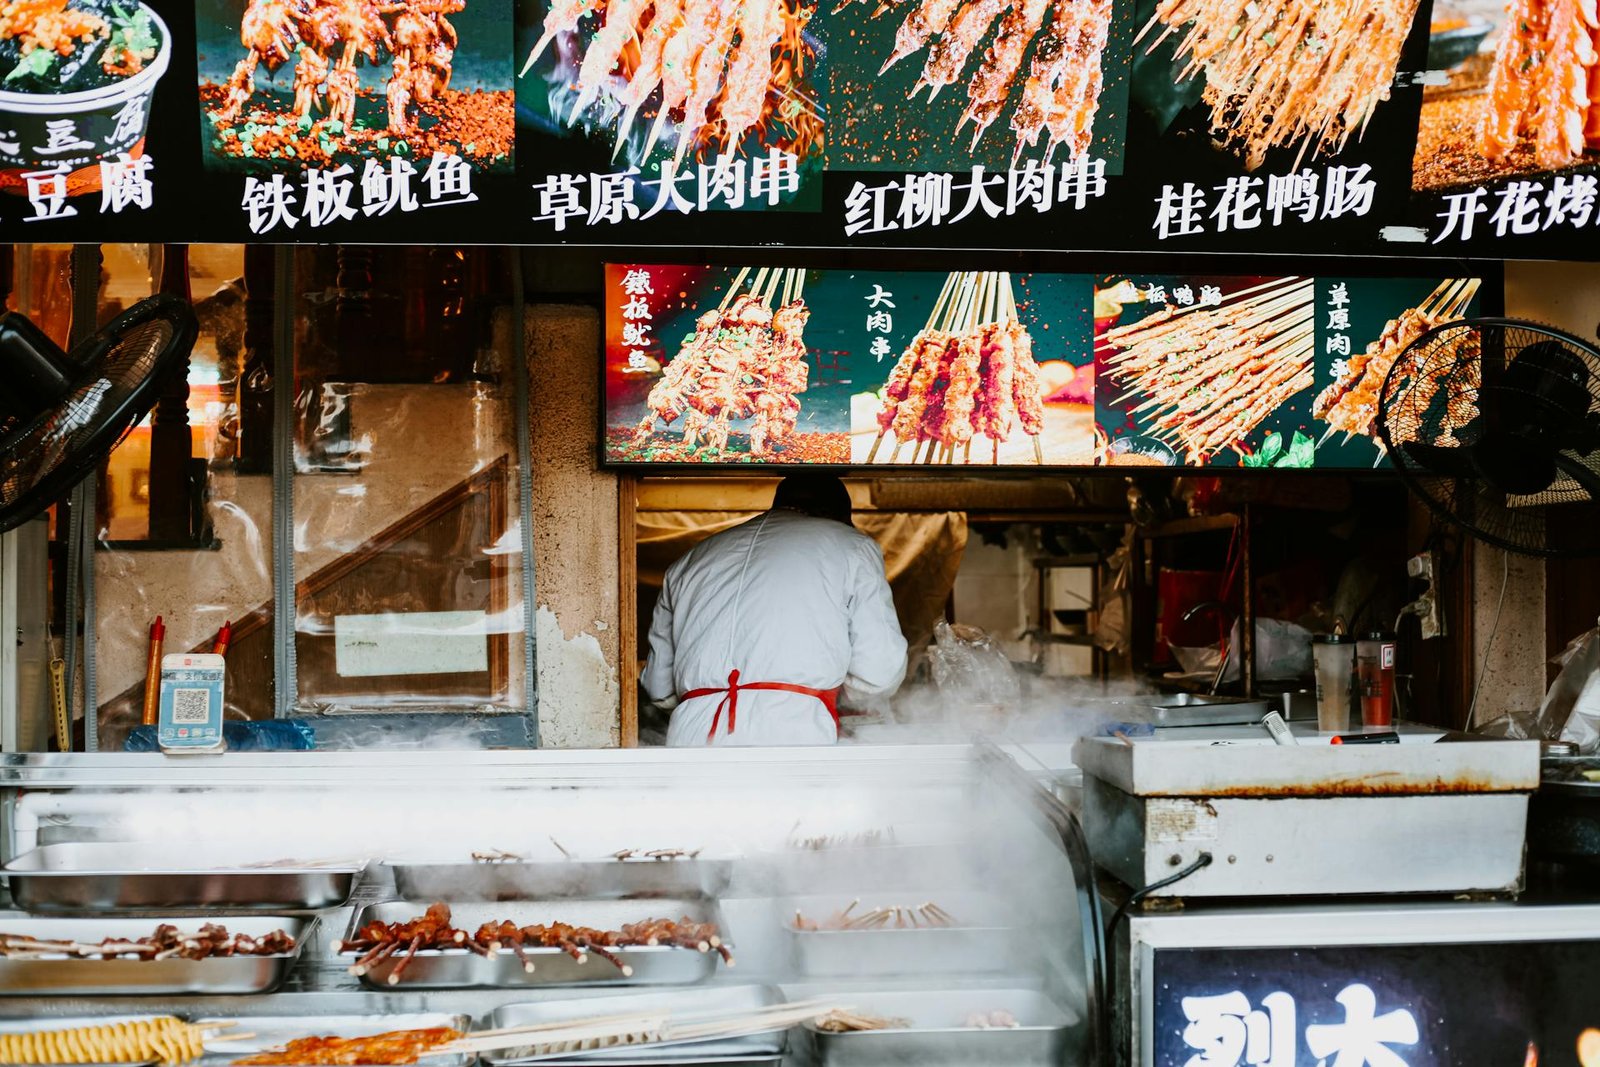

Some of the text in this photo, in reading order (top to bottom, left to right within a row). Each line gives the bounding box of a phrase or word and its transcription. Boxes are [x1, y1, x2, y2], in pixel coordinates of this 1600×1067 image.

[0, 153, 154, 222] 豆腐
[241, 151, 479, 235] 铁板鱿鱼
[532, 147, 800, 232] 草原大肉串
[844, 154, 1107, 237] 红柳大肉串
[1152, 163, 1377, 240] 桂花鸭肠
[1432, 174, 1600, 245] 开花烤
[864, 284, 896, 363] 大肉串
[1118, 281, 1223, 306] 板鸭肠
[1326, 282, 1351, 384] 草原肉串
